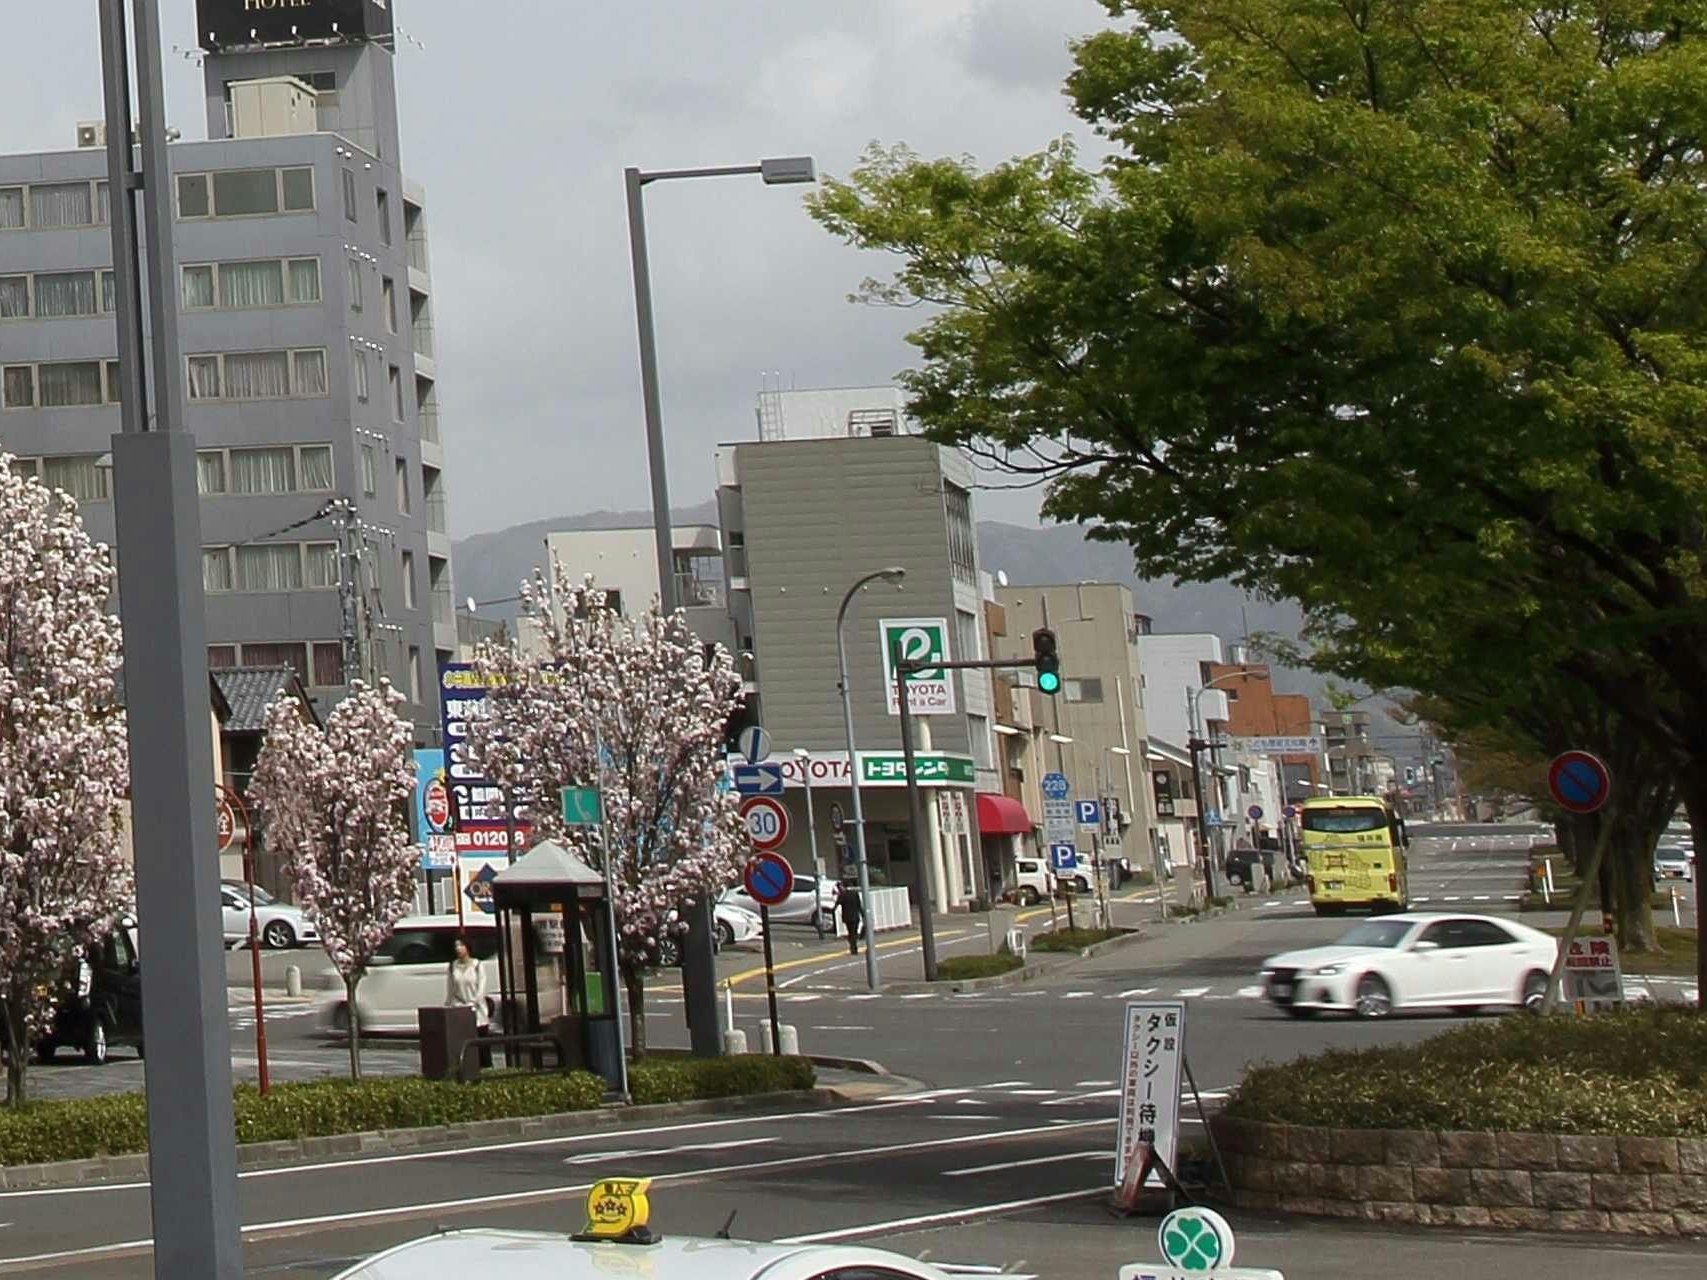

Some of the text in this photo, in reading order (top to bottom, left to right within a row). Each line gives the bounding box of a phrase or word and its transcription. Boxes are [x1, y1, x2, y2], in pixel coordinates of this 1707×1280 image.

[892, 684, 947, 695] TYOTA
[1080, 802, 1095, 822] P
[750, 811, 777, 834] 30
[473, 830, 508, 846] 0120
[1056, 846, 1072, 866] P
